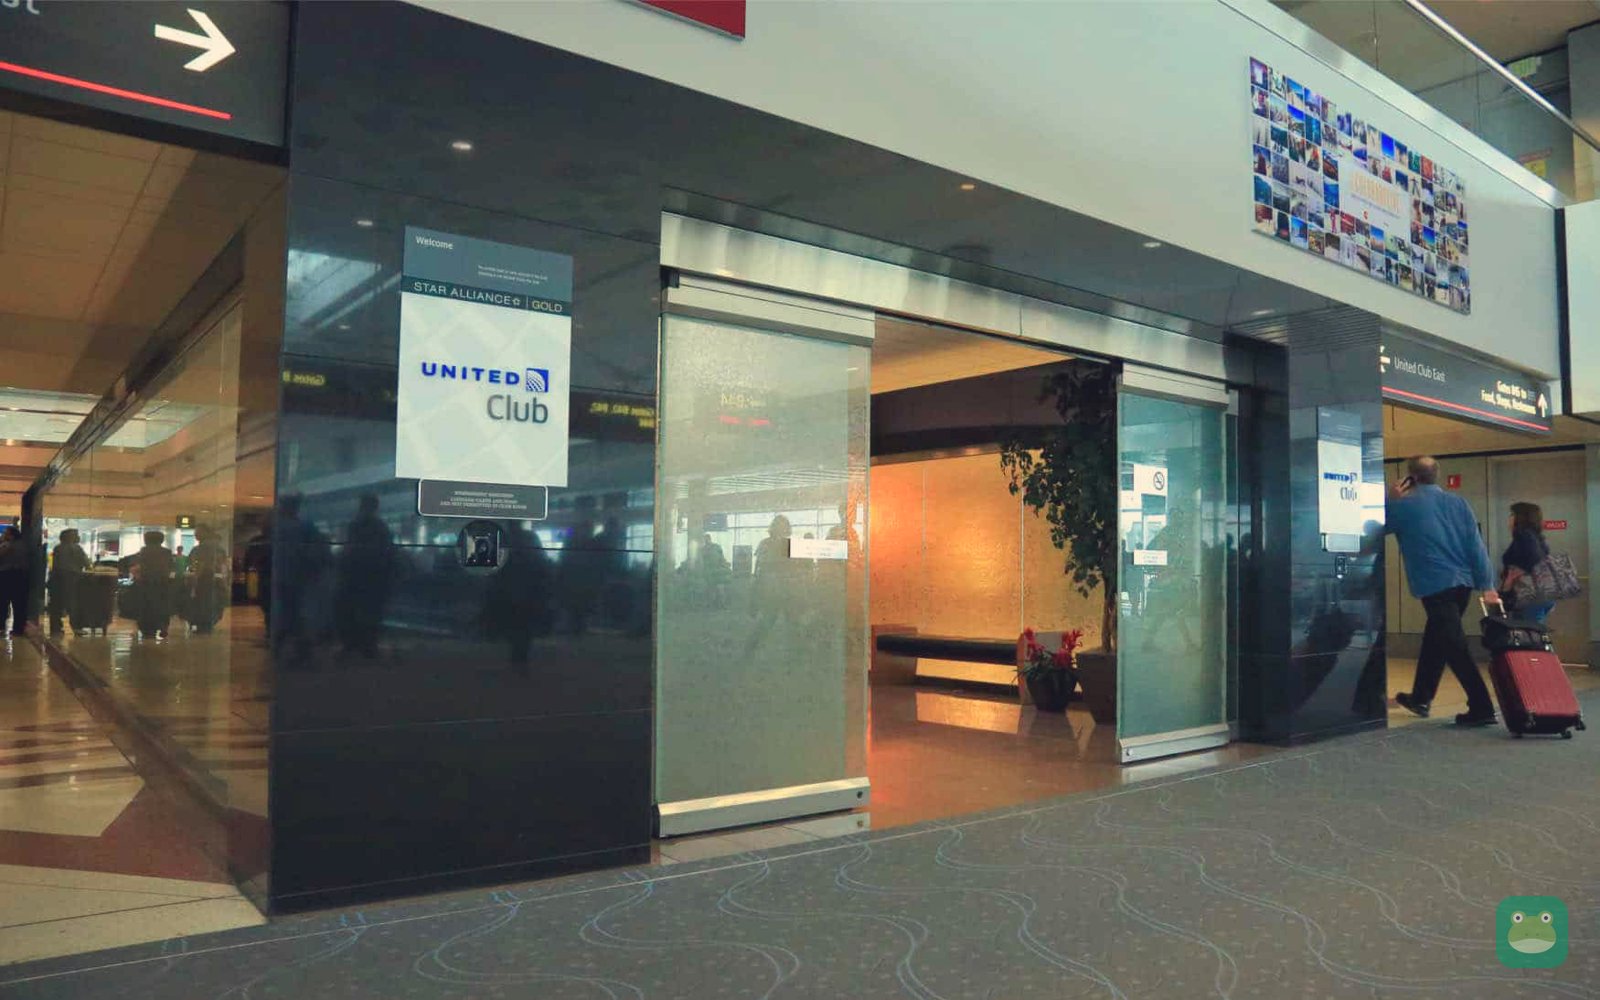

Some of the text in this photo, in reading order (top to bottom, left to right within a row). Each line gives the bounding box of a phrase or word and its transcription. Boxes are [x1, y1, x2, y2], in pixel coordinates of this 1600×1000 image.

[415, 235, 453, 250] Welcome
[413, 281, 562, 313] STAR ALLIANCE GOLD
[421, 362, 520, 385] UNITED
[1394, 356, 1447, 383] United Club East
[487, 394, 549, 424] Club
